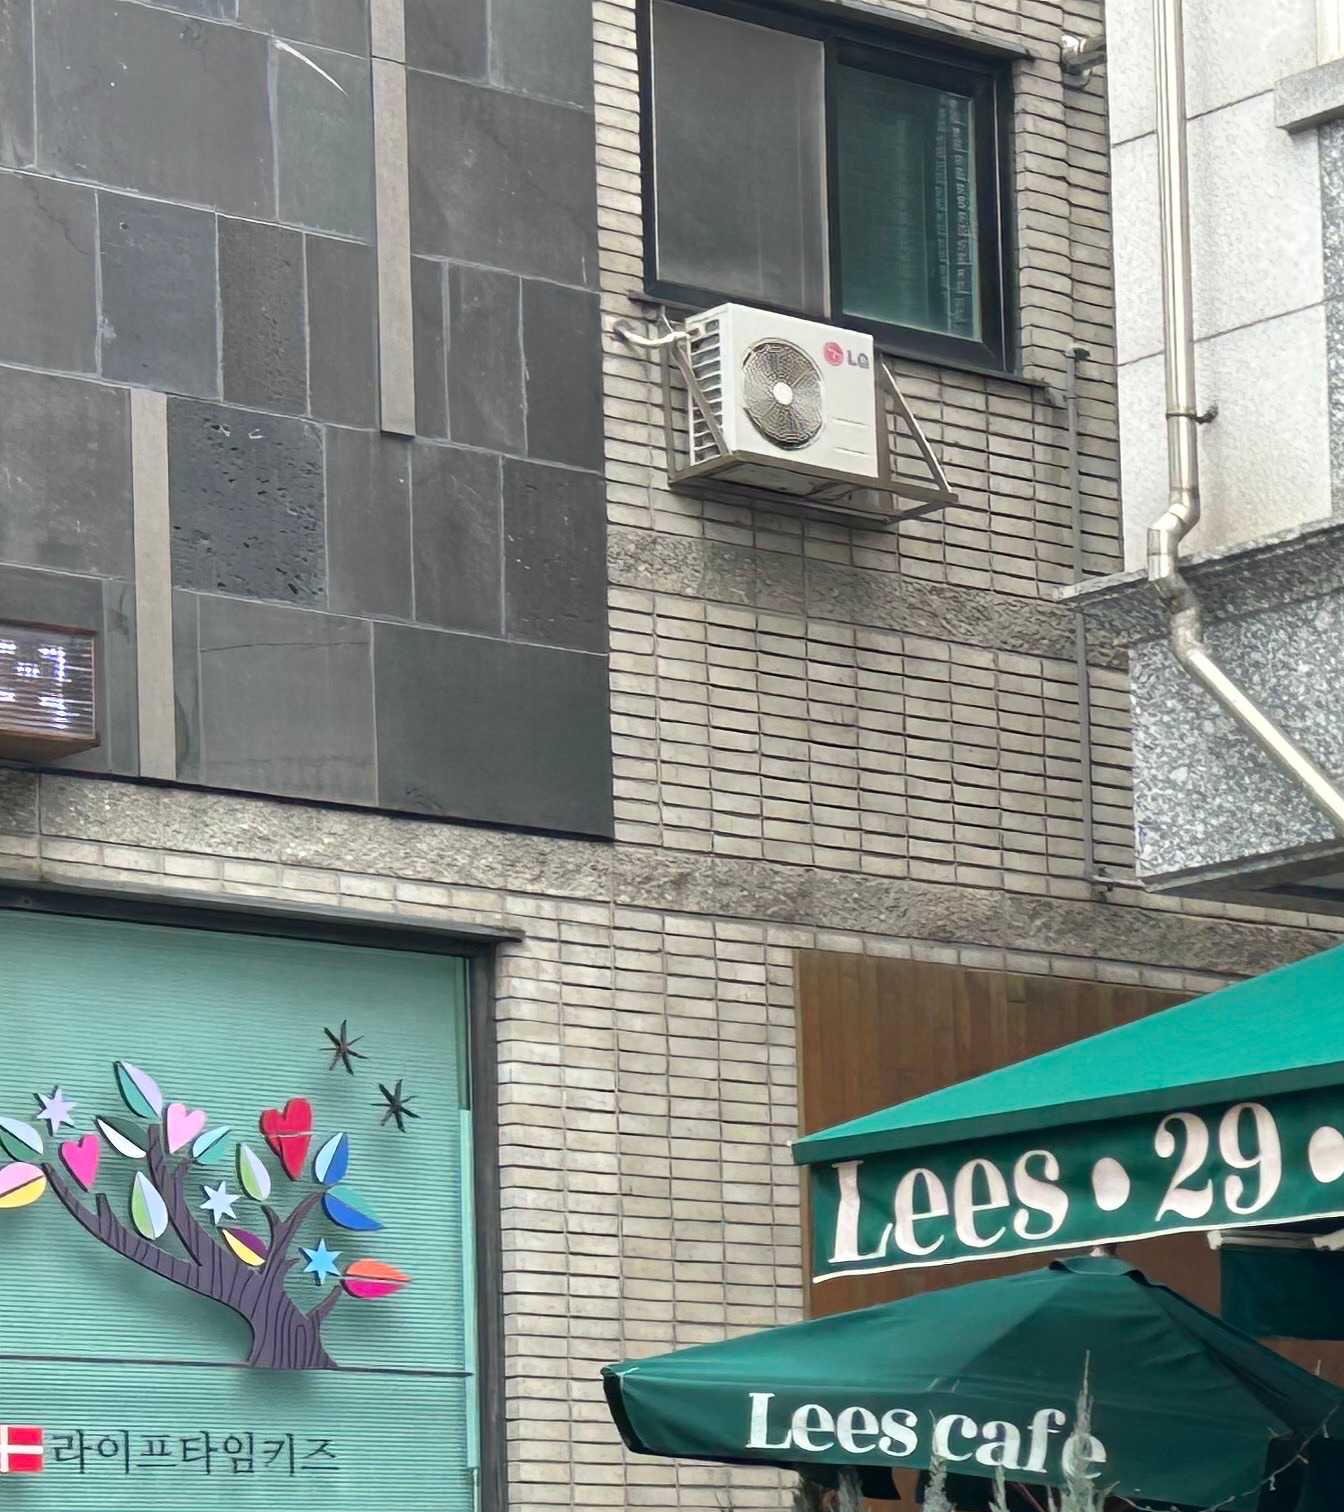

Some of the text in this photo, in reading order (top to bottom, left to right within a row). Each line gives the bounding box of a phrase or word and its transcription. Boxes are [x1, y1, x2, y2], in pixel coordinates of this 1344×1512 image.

[847, 350, 870, 369] LG
[829, 1149, 1069, 1264] Lees
[1153, 1101, 1283, 1221] 29
[51, 1428, 341, 1476] 라이프타임키즈
[746, 1391, 1107, 1479] Lees cafe
